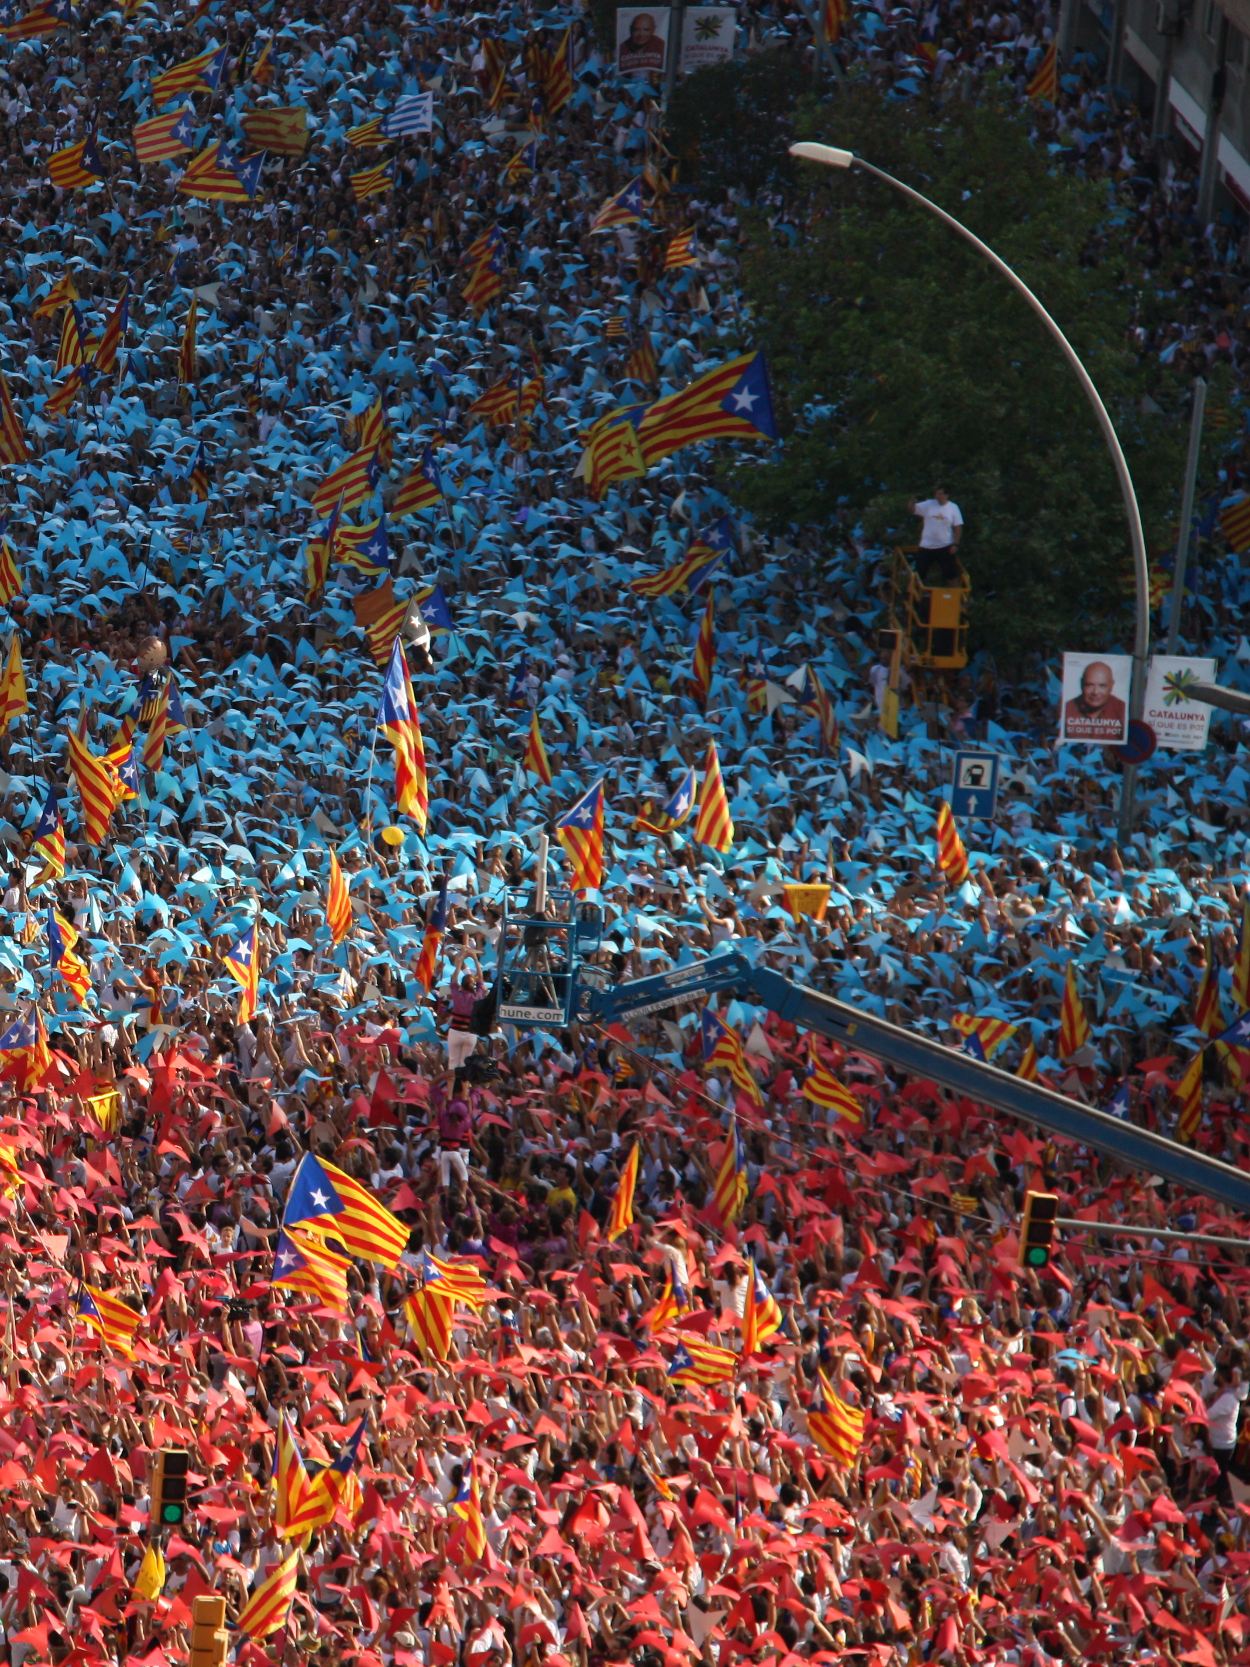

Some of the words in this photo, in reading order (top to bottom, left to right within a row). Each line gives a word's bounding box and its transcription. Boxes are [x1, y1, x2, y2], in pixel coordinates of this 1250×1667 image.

[1149, 709, 1206, 721] CATALUNYA
[1067, 717, 1122, 727] CATALUNYA
[1157, 721, 1174, 730] QUE
[1077, 726, 1092, 734] QUE
[1095, 727, 1105, 735] ES
[666, 966, 704, 983] hune.com
[500, 1008, 564, 1020] hune.com
